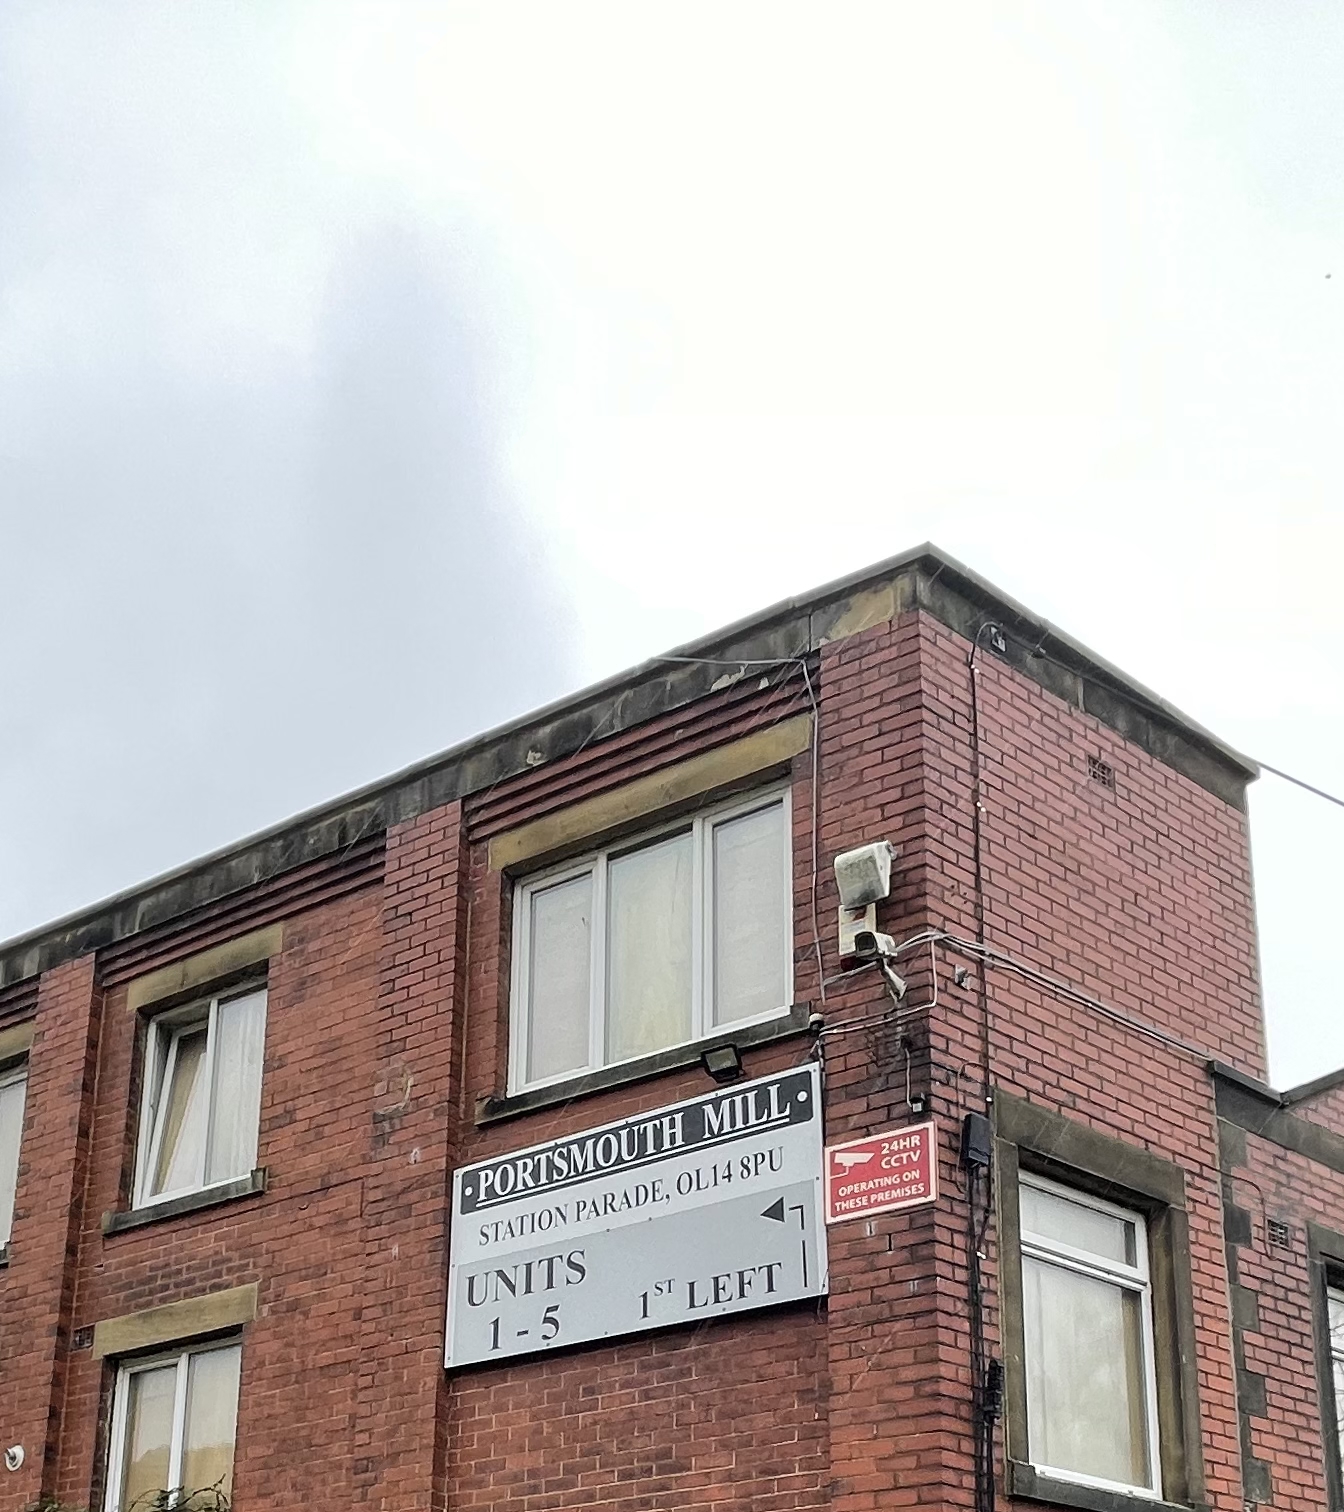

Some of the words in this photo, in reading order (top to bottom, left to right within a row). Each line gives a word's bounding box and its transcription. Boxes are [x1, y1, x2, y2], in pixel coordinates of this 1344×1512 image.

[477, 1112, 685, 1201] PORTSMOUTH
[702, 1084, 791, 1138] MILL
[880, 1135, 921, 1154] 24HR
[880, 1149, 921, 1169] CCTV
[479, 1204, 568, 1246] STATION
[575, 1179, 670, 1223] PARADE,
[676, 1160, 733, 1195] OL14
[739, 1146, 784, 1180] 8PU
[835, 1195, 868, 1212] THESE
[870, 1183, 925, 1204] PREMISES
[838, 1174, 900, 1197] OPERATING
[902, 1169, 920, 1185] ON
[465, 1249, 587, 1307] UNITS
[686, 1262, 782, 1310] LEFT
[489, 1316, 502, 1351] 1
[541, 1304, 560, 1341] 5
